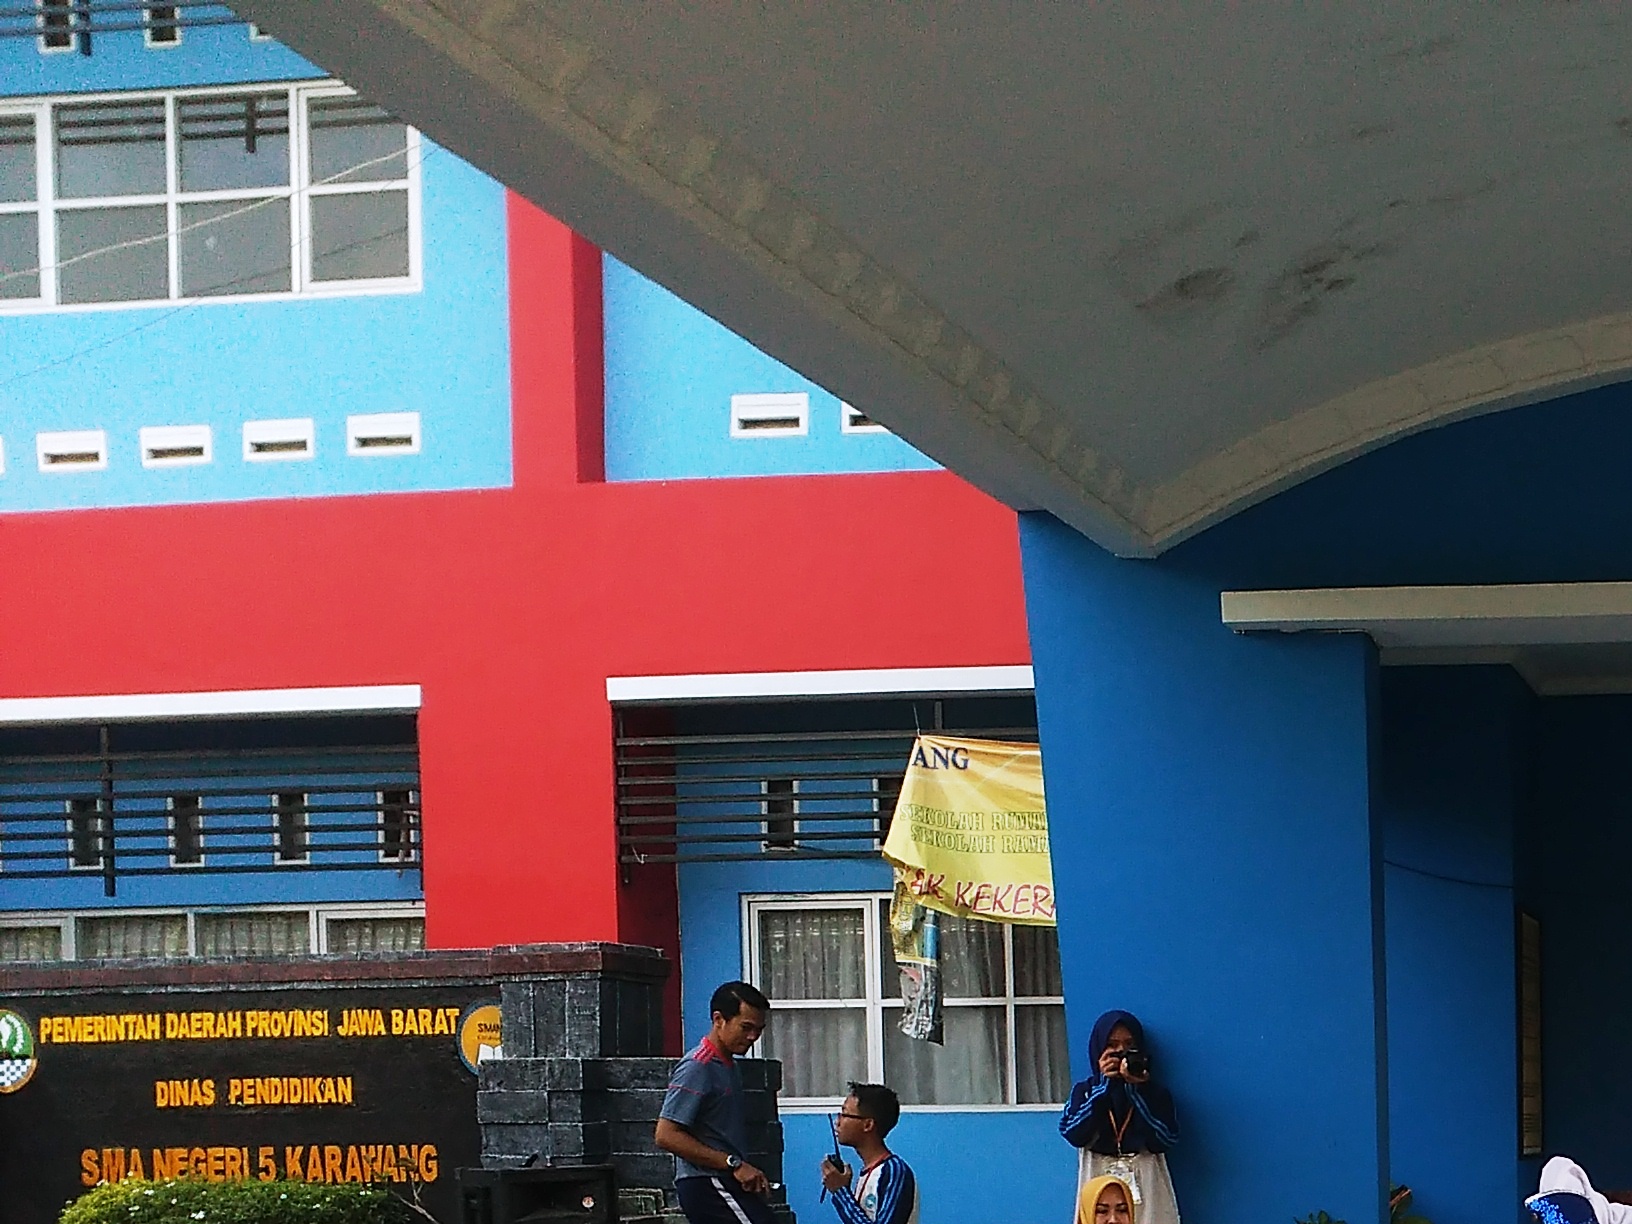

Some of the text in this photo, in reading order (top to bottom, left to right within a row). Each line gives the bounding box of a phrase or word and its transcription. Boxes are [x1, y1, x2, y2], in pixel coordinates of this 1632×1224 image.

[911, 745, 970, 770] ANG
[900, 803, 984, 831] SEKOLAH
[911, 824, 995, 853] SEKOLAH
[40, 1008, 460, 1044] PEMERINTAH DAERAH PROVINSI JAWA BARAT
[155, 1076, 353, 1107] DINAS PENDIDIKAN
[81, 1144, 438, 1187] SMA NEGERI 5 KARAWANG
